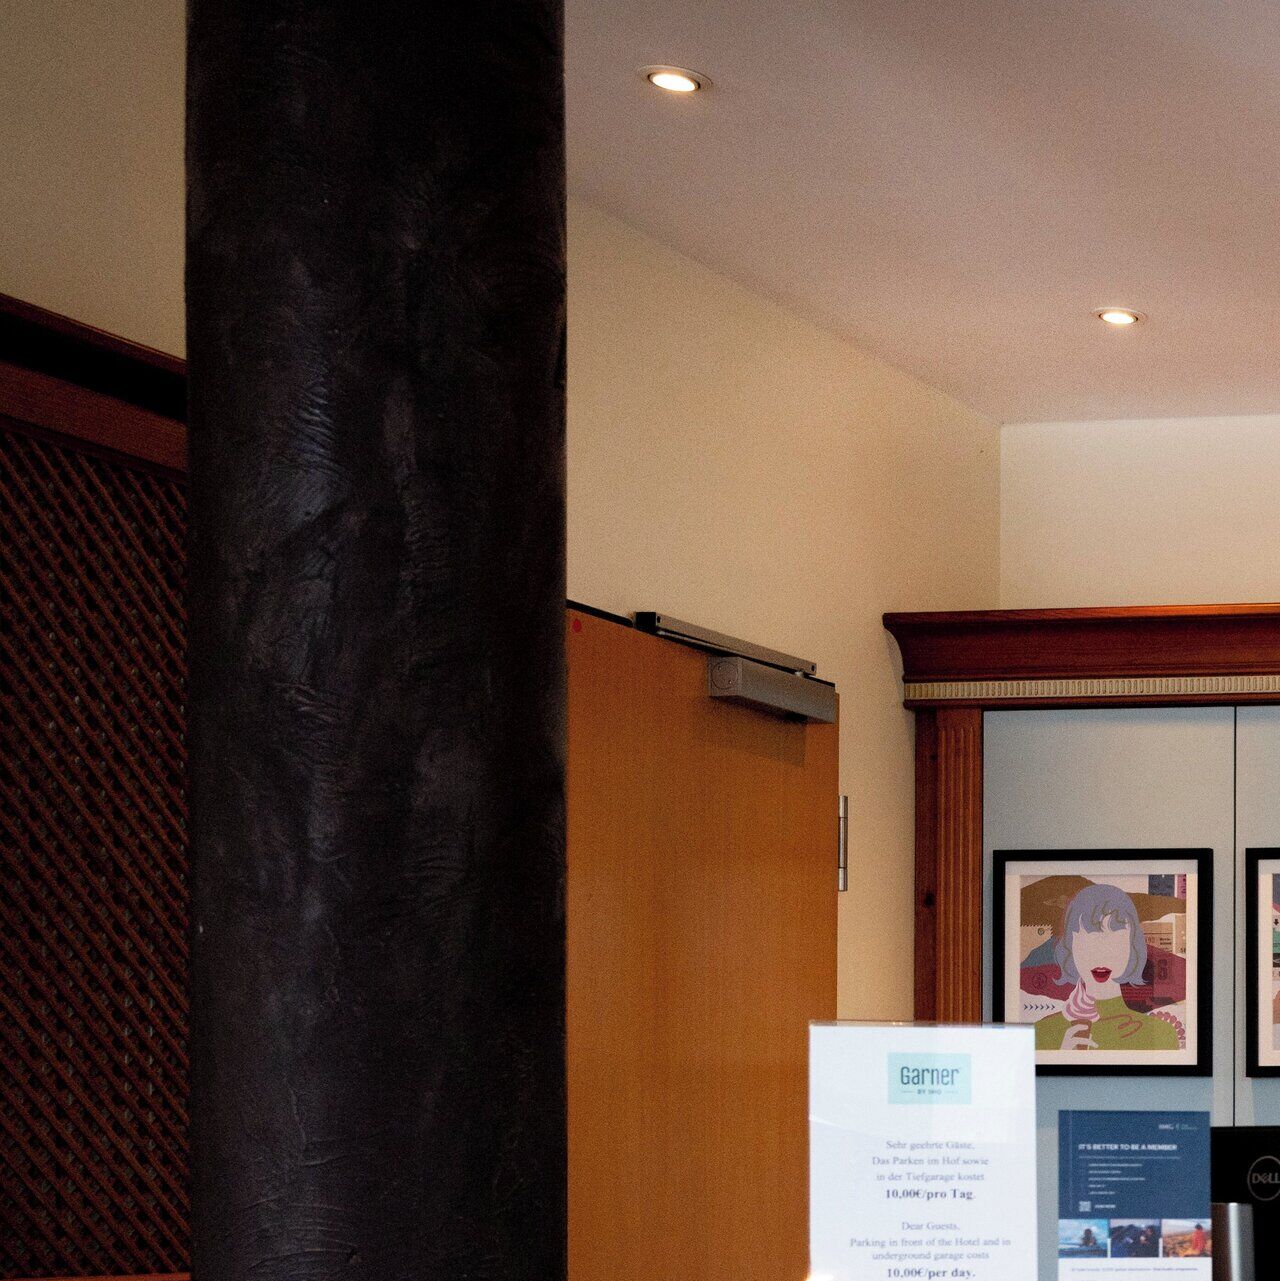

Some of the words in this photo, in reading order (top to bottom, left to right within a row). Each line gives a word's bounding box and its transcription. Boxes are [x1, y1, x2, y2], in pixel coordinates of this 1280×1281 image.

[901, 1066, 960, 1086] Garner
[886, 1141, 906, 1149] Sehr
[910, 1141, 944, 1151] geehrte
[1120, 1143, 1130, 1151] TO
[872, 1157, 890, 1165] Das
[892, 1157, 925, 1165] Parken
[927, 1157, 939, 1165] im
[942, 1157, 961, 1165] Hof
[962, 1157, 989, 1165] sowie
[876, 1173, 885, 1181] in
[888, 1173, 903, 1181] der
[906, 1172, 955, 1183] Tiefgarage
[958, 1172, 985, 1181] kostet
[1252, 1172, 1280, 1184] DELL
[902, 1221, 923, 1230] Dear
[850, 1238, 886, 1248] Parking
[889, 1238, 898, 1246] in
[901, 1238, 923, 1246] front
[926, 1238, 936, 1246] of
[938, 1238, 952, 1246] the
[955, 1238, 980, 1246] Hotel
[983, 1238, 999, 1246] and
[1002, 1237, 1011, 1246] in
[872, 1252, 931, 1261] underground
[934, 1253, 964, 1261] garage
[967, 1252, 989, 1260] costs
[951, 1268, 976, 1279] day.
